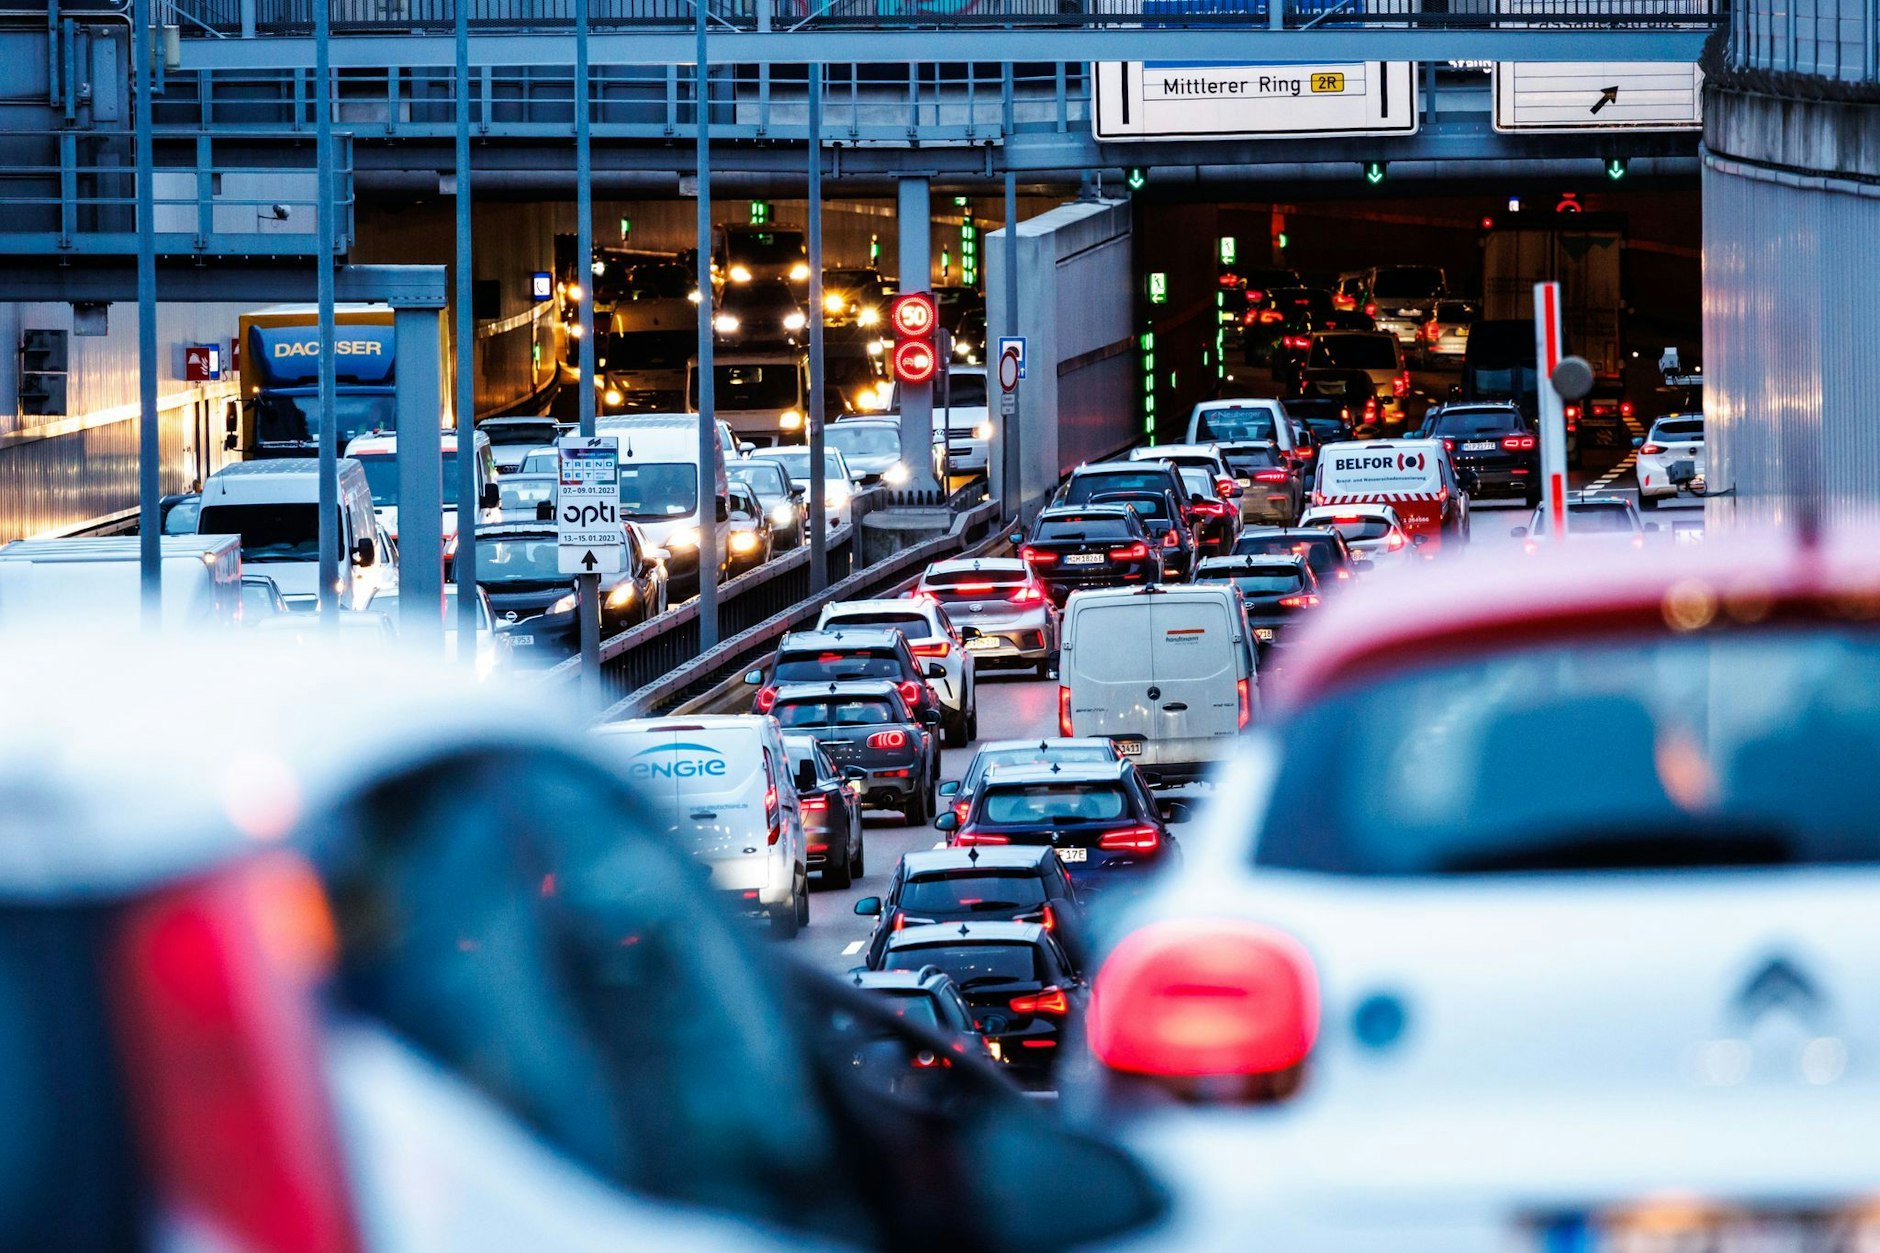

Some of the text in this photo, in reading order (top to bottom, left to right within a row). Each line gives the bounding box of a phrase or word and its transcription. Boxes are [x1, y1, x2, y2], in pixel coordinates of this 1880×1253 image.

[1163, 76, 1301, 97] Mittlerer Ring
[1317, 76, 1337, 90] 2R
[901, 304, 927, 327] 50
[274, 340, 382, 358] DACSER
[1217, 410, 1261, 418] Neuberger
[1335, 457, 1393, 471] BELFOR
[563, 500, 615, 527] opti
[1066, 849, 1086, 860] 17E
